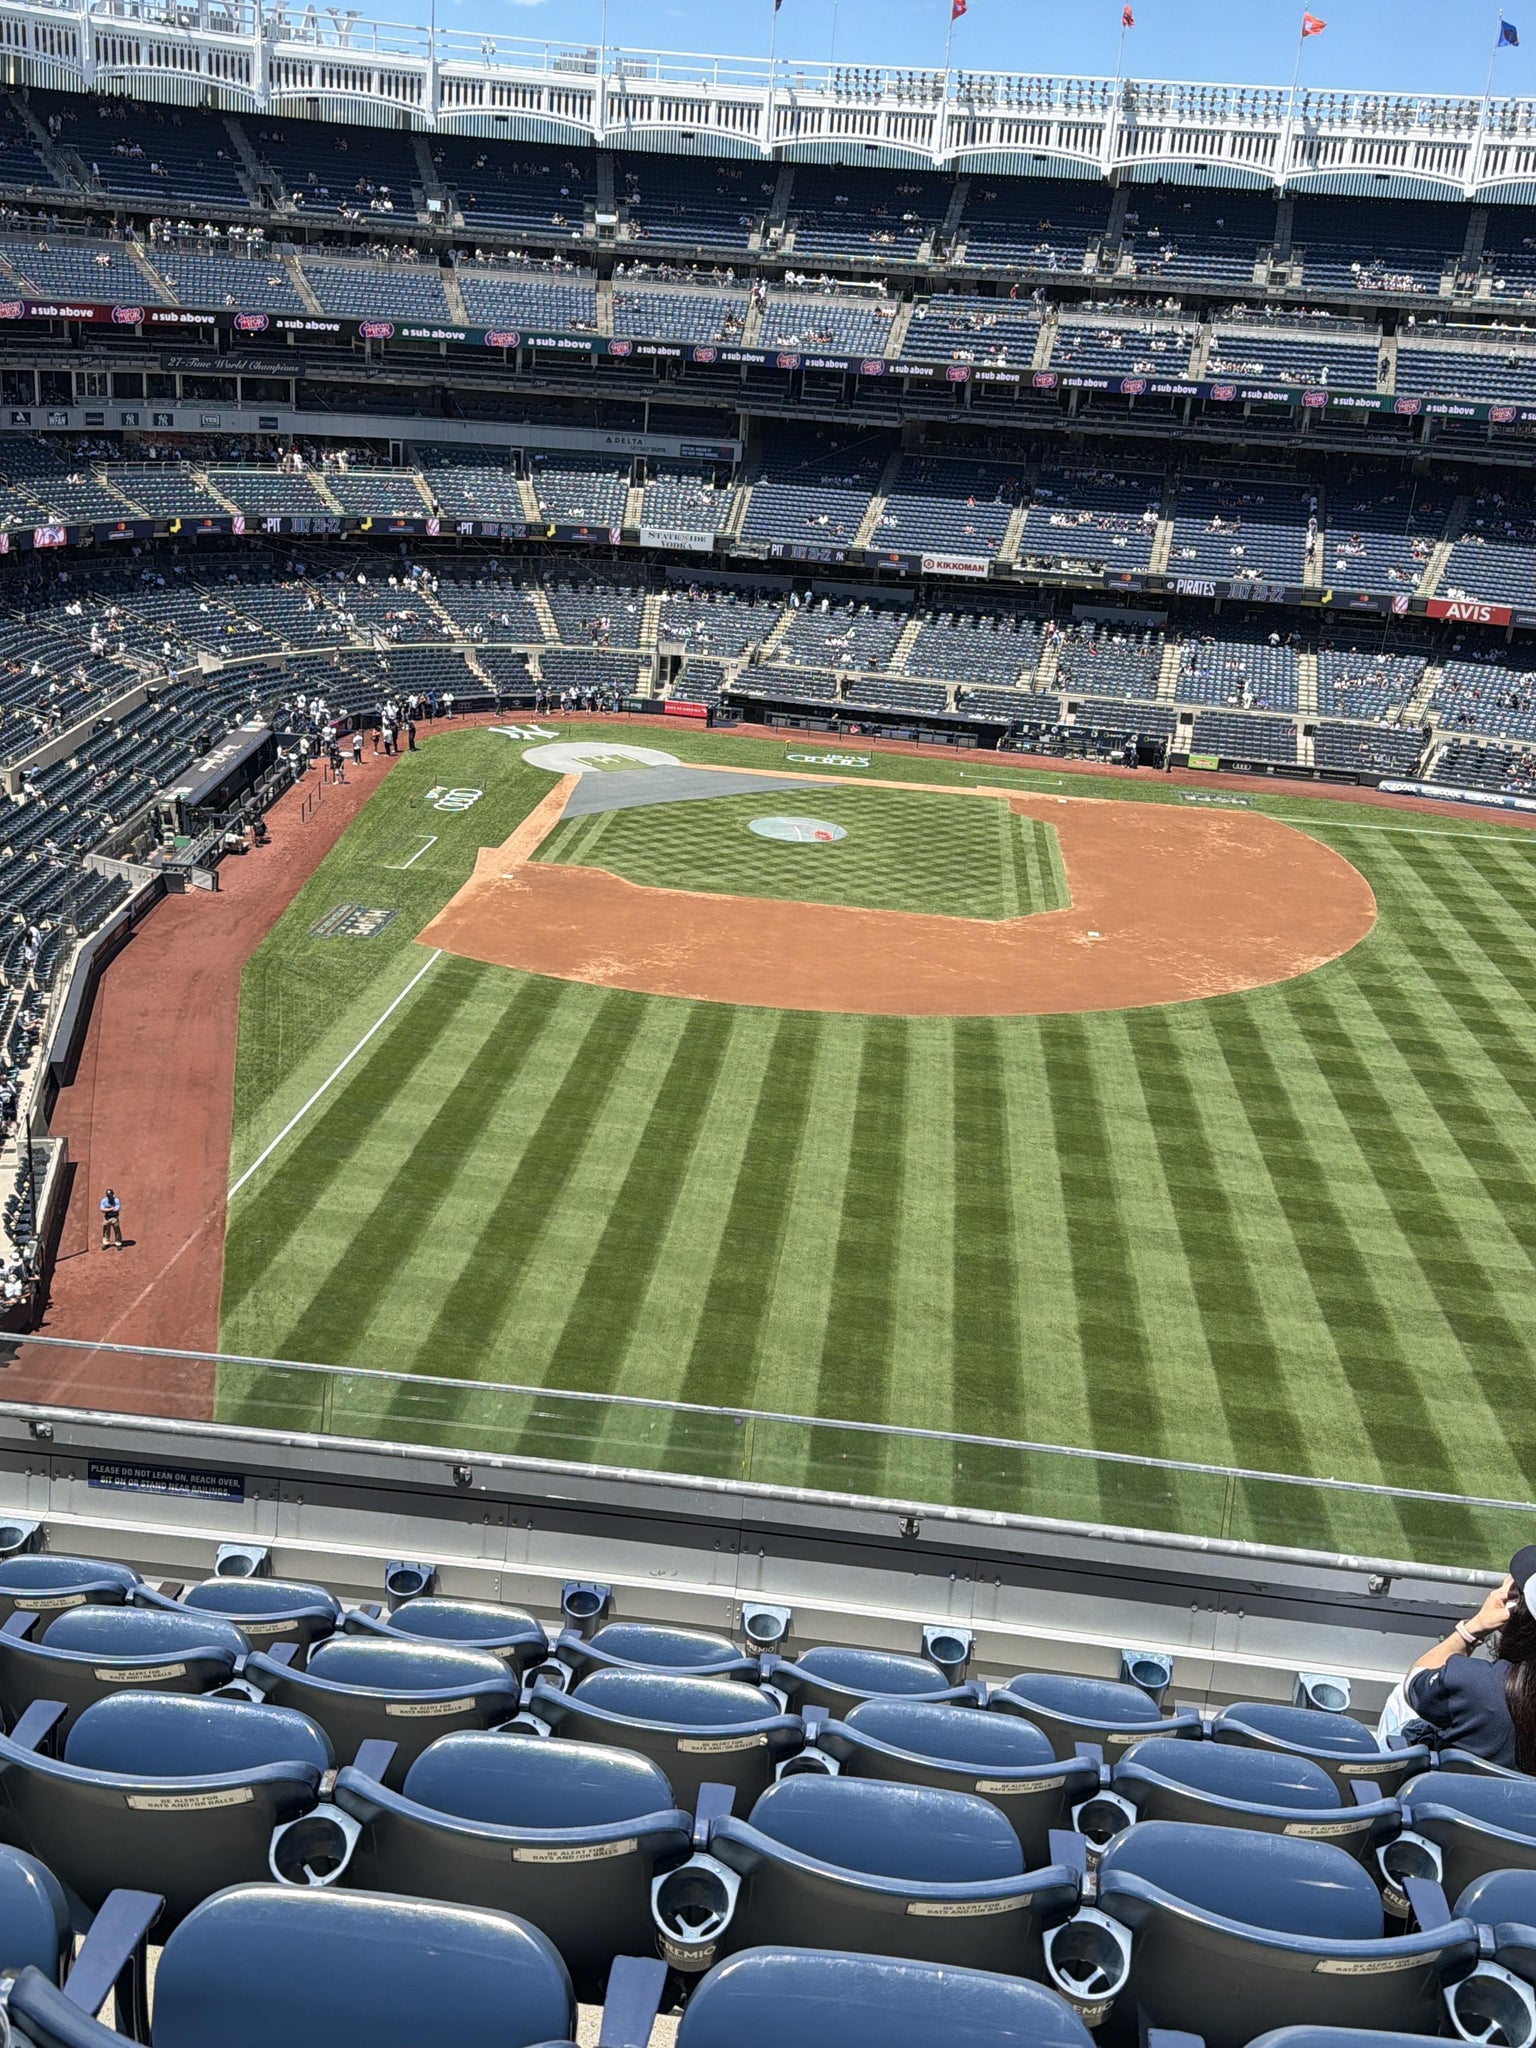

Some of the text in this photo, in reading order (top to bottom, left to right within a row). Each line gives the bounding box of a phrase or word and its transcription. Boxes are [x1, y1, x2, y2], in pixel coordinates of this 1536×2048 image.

[38, 306, 58, 315] sub
[60, 307, 93, 317] above
[160, 313, 178, 321] sub
[180, 313, 215, 323] above
[285, 320, 303, 328] sub
[305, 321, 339, 331] above
[411, 329, 430, 337] sub
[432, 330, 465, 339] above
[536, 338, 556, 346] sub
[558, 339, 591, 349] above
[643, 346, 656, 354] sub
[657, 347, 680, 356] above
[728, 352, 741, 360] sub
[742, 353, 764, 362] above
[168, 357, 300, 374] 27-Time World Champions
[811, 359, 824, 367] sub
[825, 360, 848, 369] above
[895, 365, 909, 373] sub
[910, 366, 933, 375] above
[996, 372, 1020, 381] above
[1069, 378, 1082, 386] sub
[1083, 379, 1107, 388] above
[1157, 384, 1171, 392] sub
[1172, 385, 1197, 394] above
[1263, 391, 1288, 400] above
[1340, 397, 1354, 405] sub
[1355, 398, 1380, 407] above
[1432, 405, 1447, 413] sub
[1448, 405, 1475, 415] above
[48, 415, 66, 425] WFAN
[267, 518, 282, 532] PIT
[290, 518, 311, 532] JULY
[461, 523, 473, 535] PIT
[481, 523, 499, 536] JULY
[648, 532, 706, 543] STATESIDE
[661, 540, 693, 549] VODKA
[771, 544, 784, 556] PIT
[791, 546, 808, 558] JULY
[937, 561, 985, 572] KIKKOMAN
[1176, 579, 1216, 596] PIRATES
[1228, 583, 1252, 599] JULY
[1446, 603, 1491, 621] AVIS
[1483, 794, 1504, 804] COOL
[91, 1464, 120, 1475] PLEASE
[122, 1467, 132, 1475] DO
[135, 1469, 150, 1477] NOT
[152, 1471, 172, 1480] LEAN
[191, 1475, 216, 1485] REACH
[100, 1475, 112, 1484] SIT
[115, 1477, 126, 1486] ON
[128, 1478, 139, 1487] OR
[140, 1480, 166, 1489] STAND
[168, 1482, 190, 1492] NEAR
[1073, 2000, 1114, 2015] EMIO
